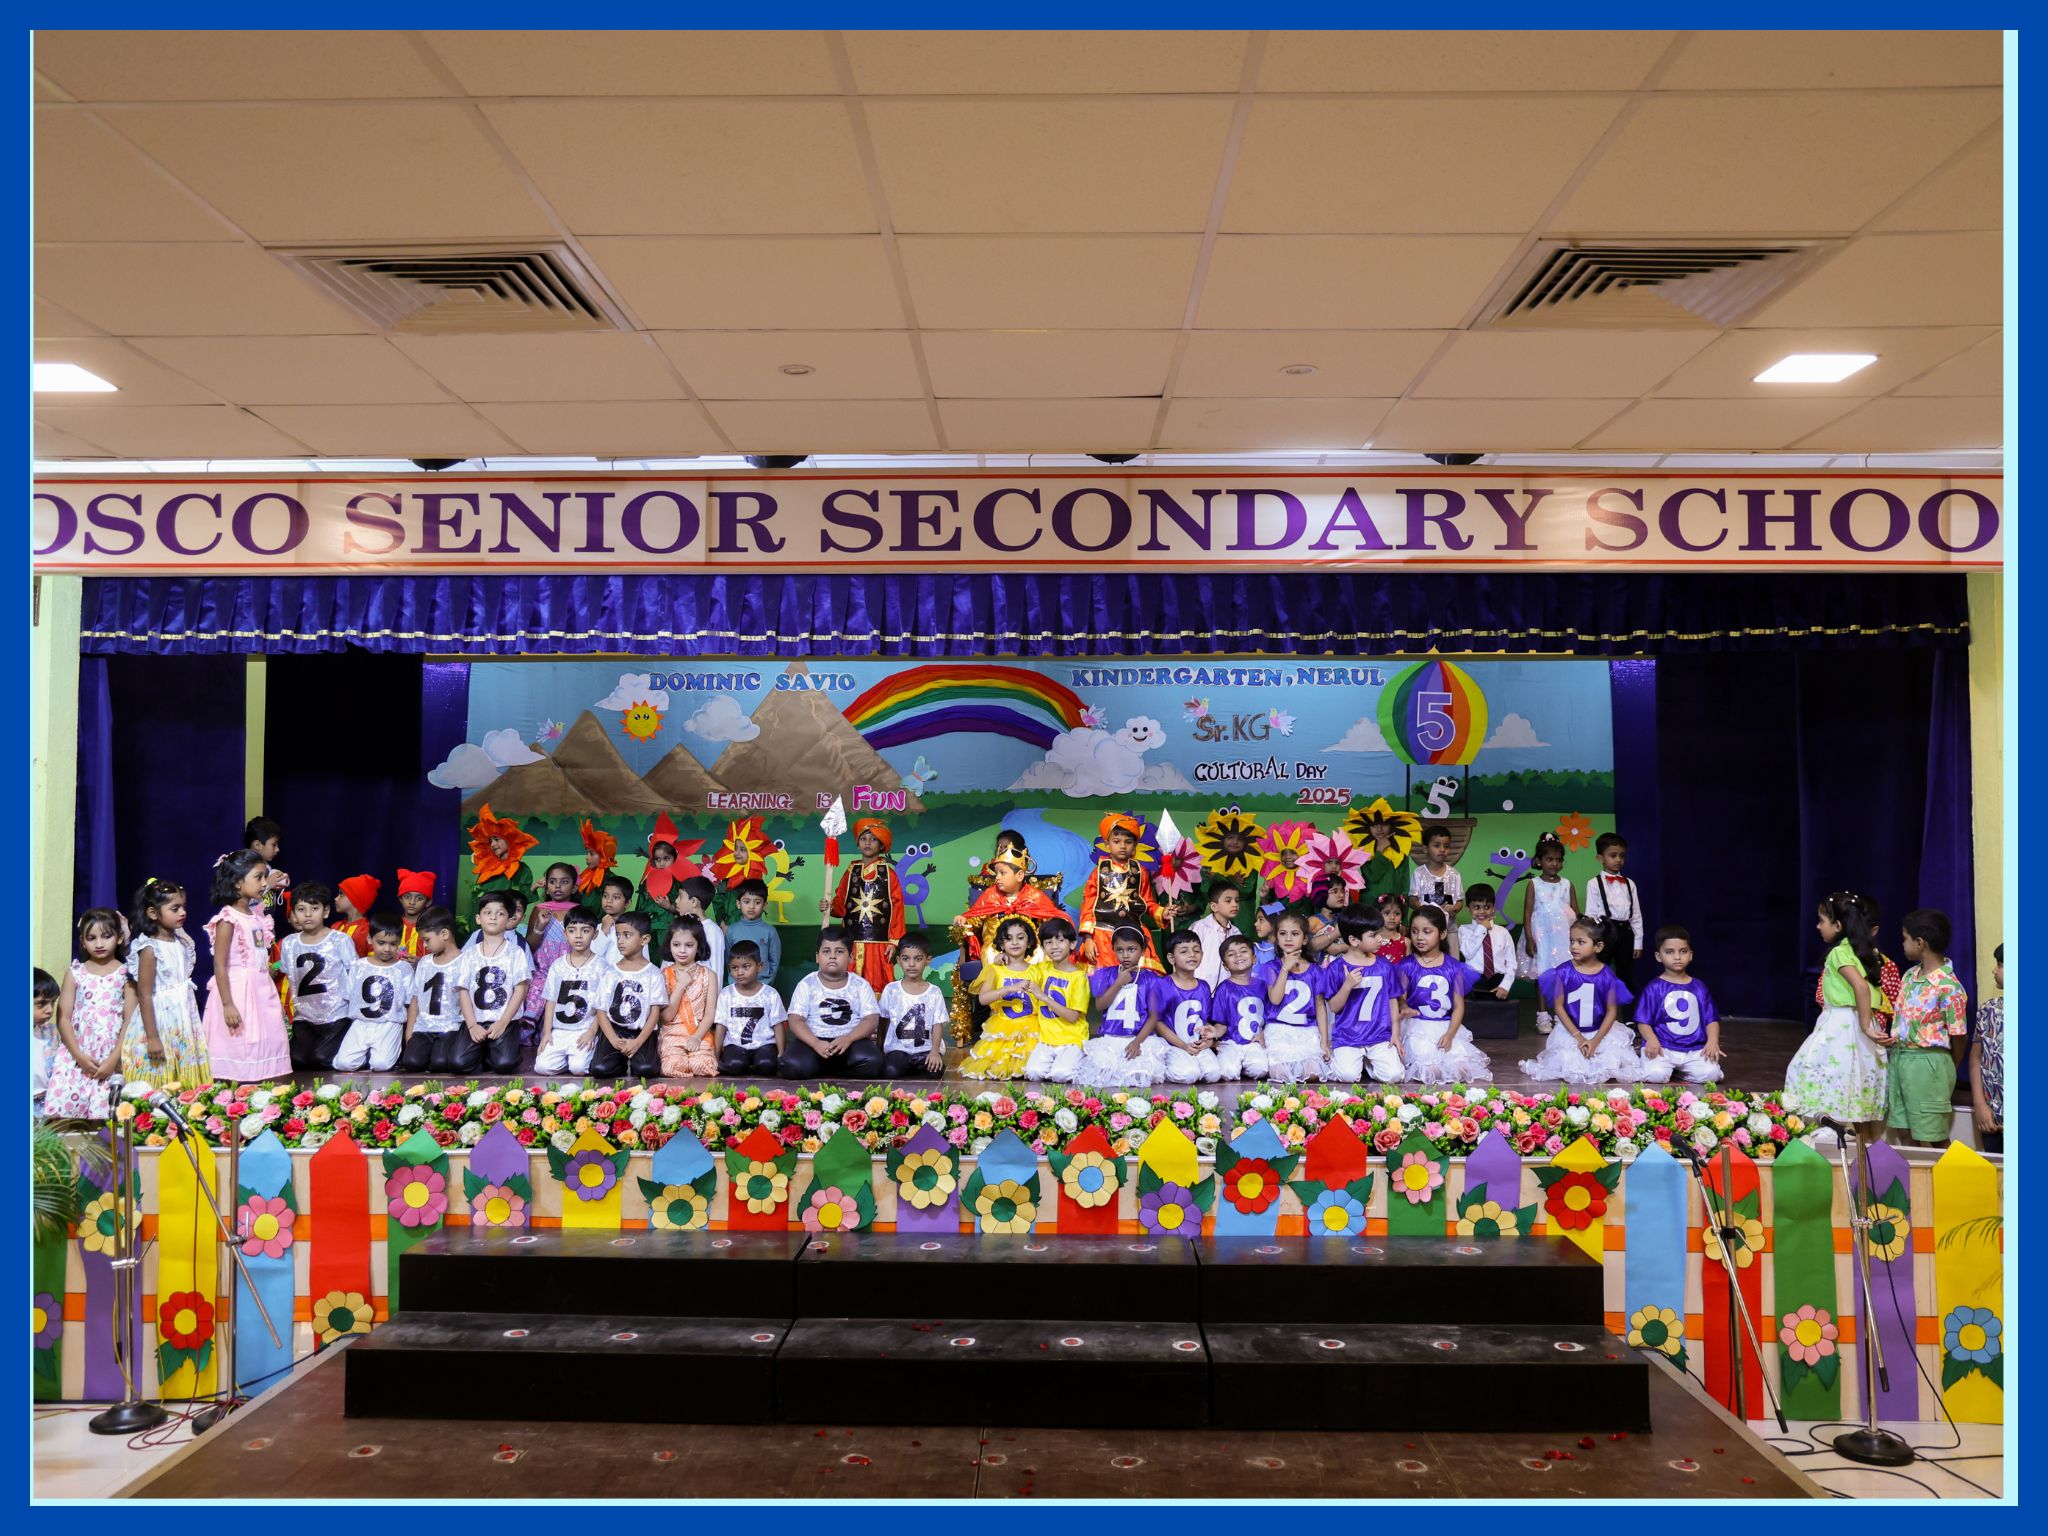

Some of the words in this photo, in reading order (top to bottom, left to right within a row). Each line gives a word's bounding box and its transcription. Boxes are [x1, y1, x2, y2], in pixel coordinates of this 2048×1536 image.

[343, 490, 786, 555] SENIOR
[820, 487, 1554, 554] SECONDARY
[1585, 487, 2000, 553] SCHOO
[649, 672, 761, 691] DOMINIC
[775, 673, 856, 691] SAVIO
[1416, 691, 1456, 751] 5
[1193, 756, 1289, 781] CULTURAL
[707, 792, 793, 810] LEARNING
[816, 792, 833, 808] IS
[851, 784, 906, 811] FUN
[1297, 787, 1352, 805] 2025
[296, 952, 328, 998] 2
[360, 975, 395, 1019] 9
[423, 972, 445, 1016] 1
[473, 965, 508, 1011] 8
[1039, 976, 1070, 1019] 5
[1416, 974, 1452, 1019] 3
[555, 980, 589, 1024] 5
[609, 979, 643, 1025] 6
[818, 997, 854, 1026] 3
[1000, 977, 1034, 1019] 5
[1106, 982, 1141, 1029] 4
[1236, 996, 1264, 1042] 8
[1276, 979, 1312, 1025] 2
[1353, 975, 1383, 1022] 7
[1567, 982, 1595, 1028] 1
[1663, 990, 1701, 1036] 9
[730, 1006, 766, 1046] 7
[895, 1002, 930, 1048] 4
[1174, 999, 1203, 1044] 6
